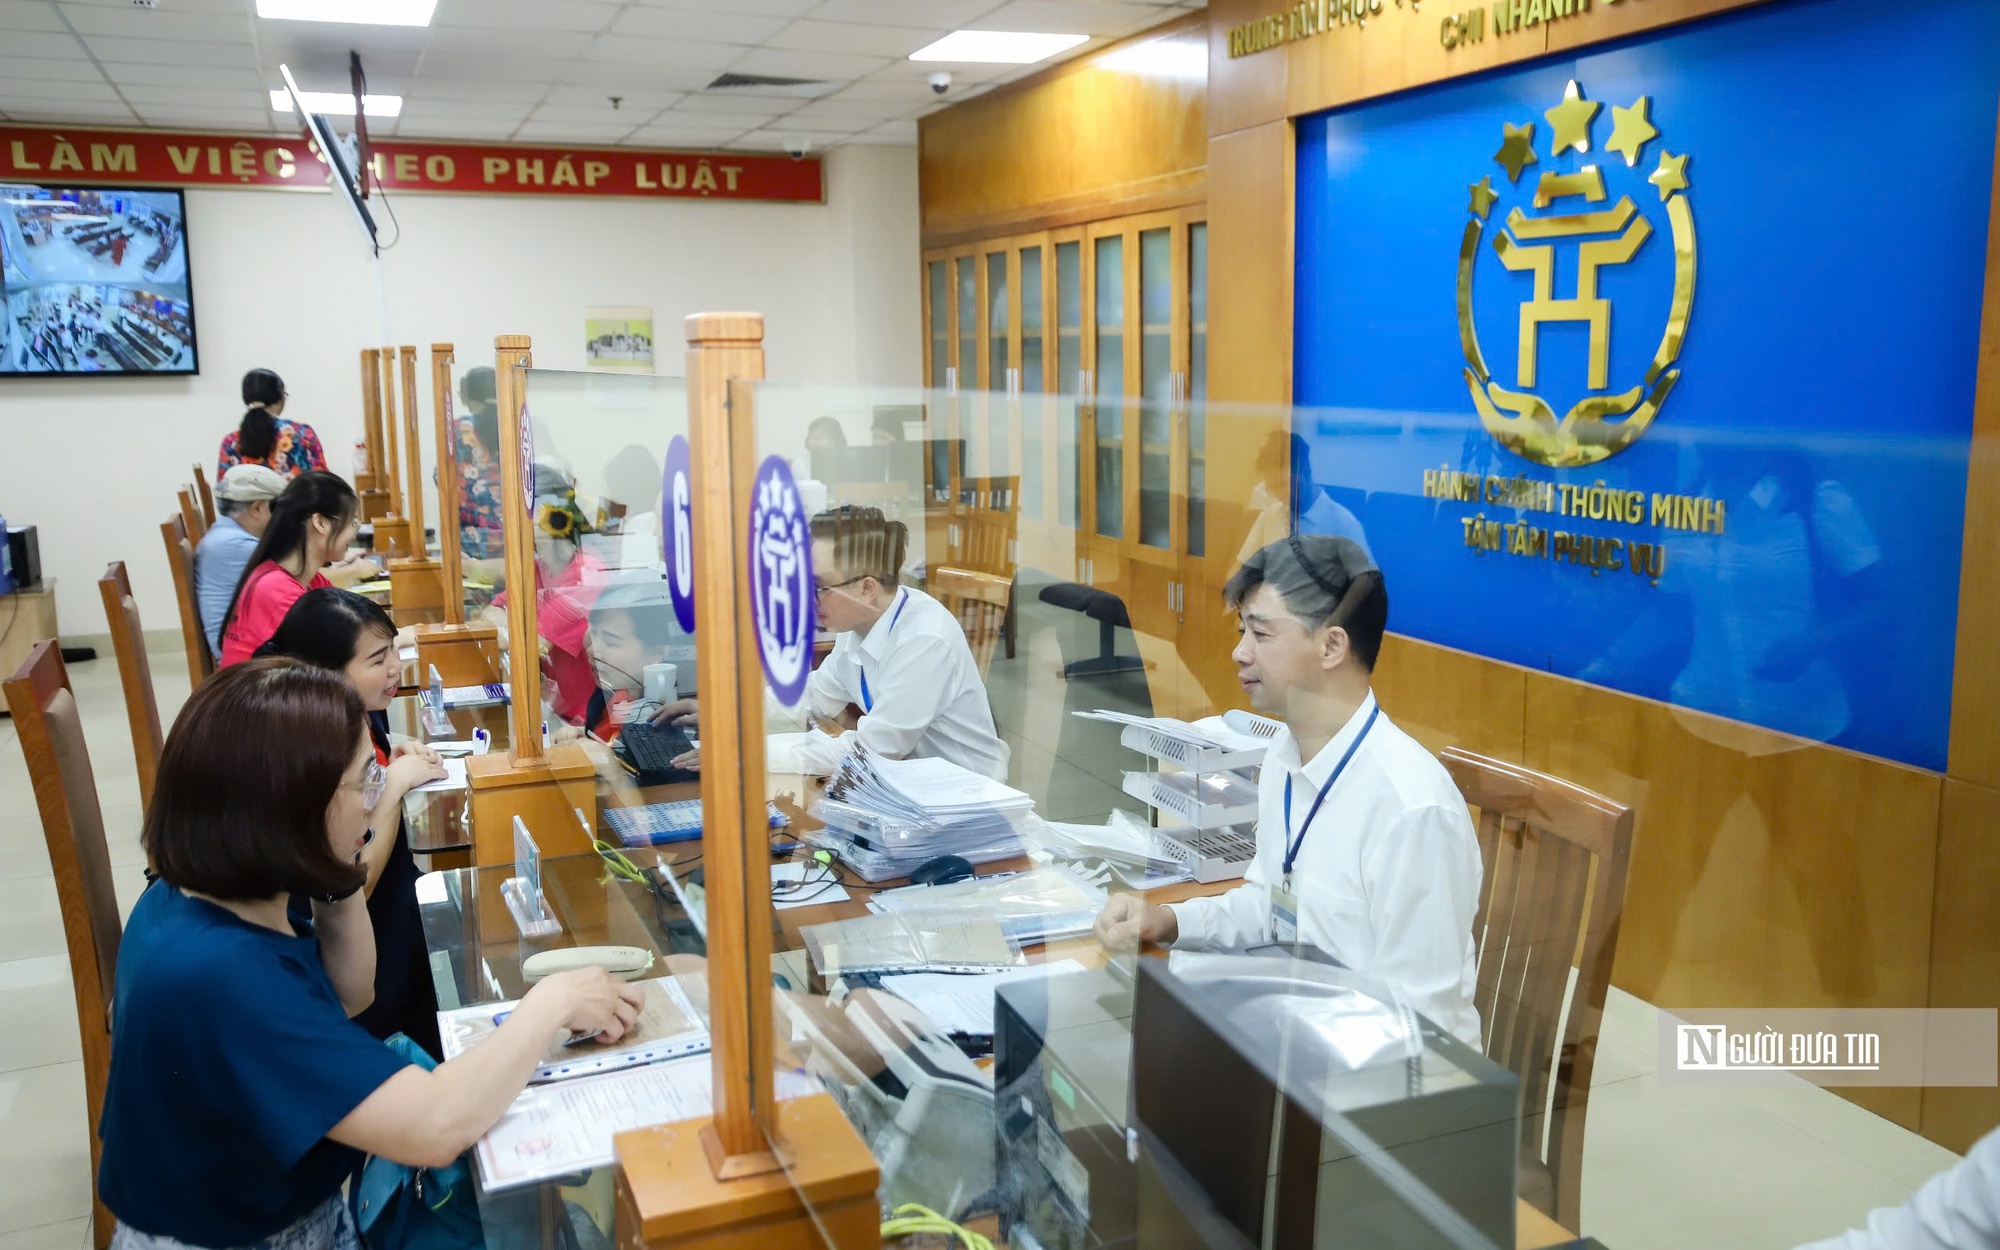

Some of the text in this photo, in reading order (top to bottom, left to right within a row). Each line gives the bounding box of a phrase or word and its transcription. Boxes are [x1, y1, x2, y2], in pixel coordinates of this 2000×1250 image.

[1225, 14, 1284, 58] TRUNG
[1440, 7, 1484, 48] CHI
[10, 135, 138, 174] LÀM
[165, 141, 297, 183] VIỆC
[482, 155, 611, 187] PHÁP
[635, 160, 743, 196] LUẬT
[1423, 464, 1480, 503] HÀNH
[1558, 480, 1645, 524] THÔNG
[1651, 493, 1725, 534] MINH
[673, 470, 691, 598] 6
[1461, 512, 1666, 587] TẬN TÂM PHỤC VỤ
